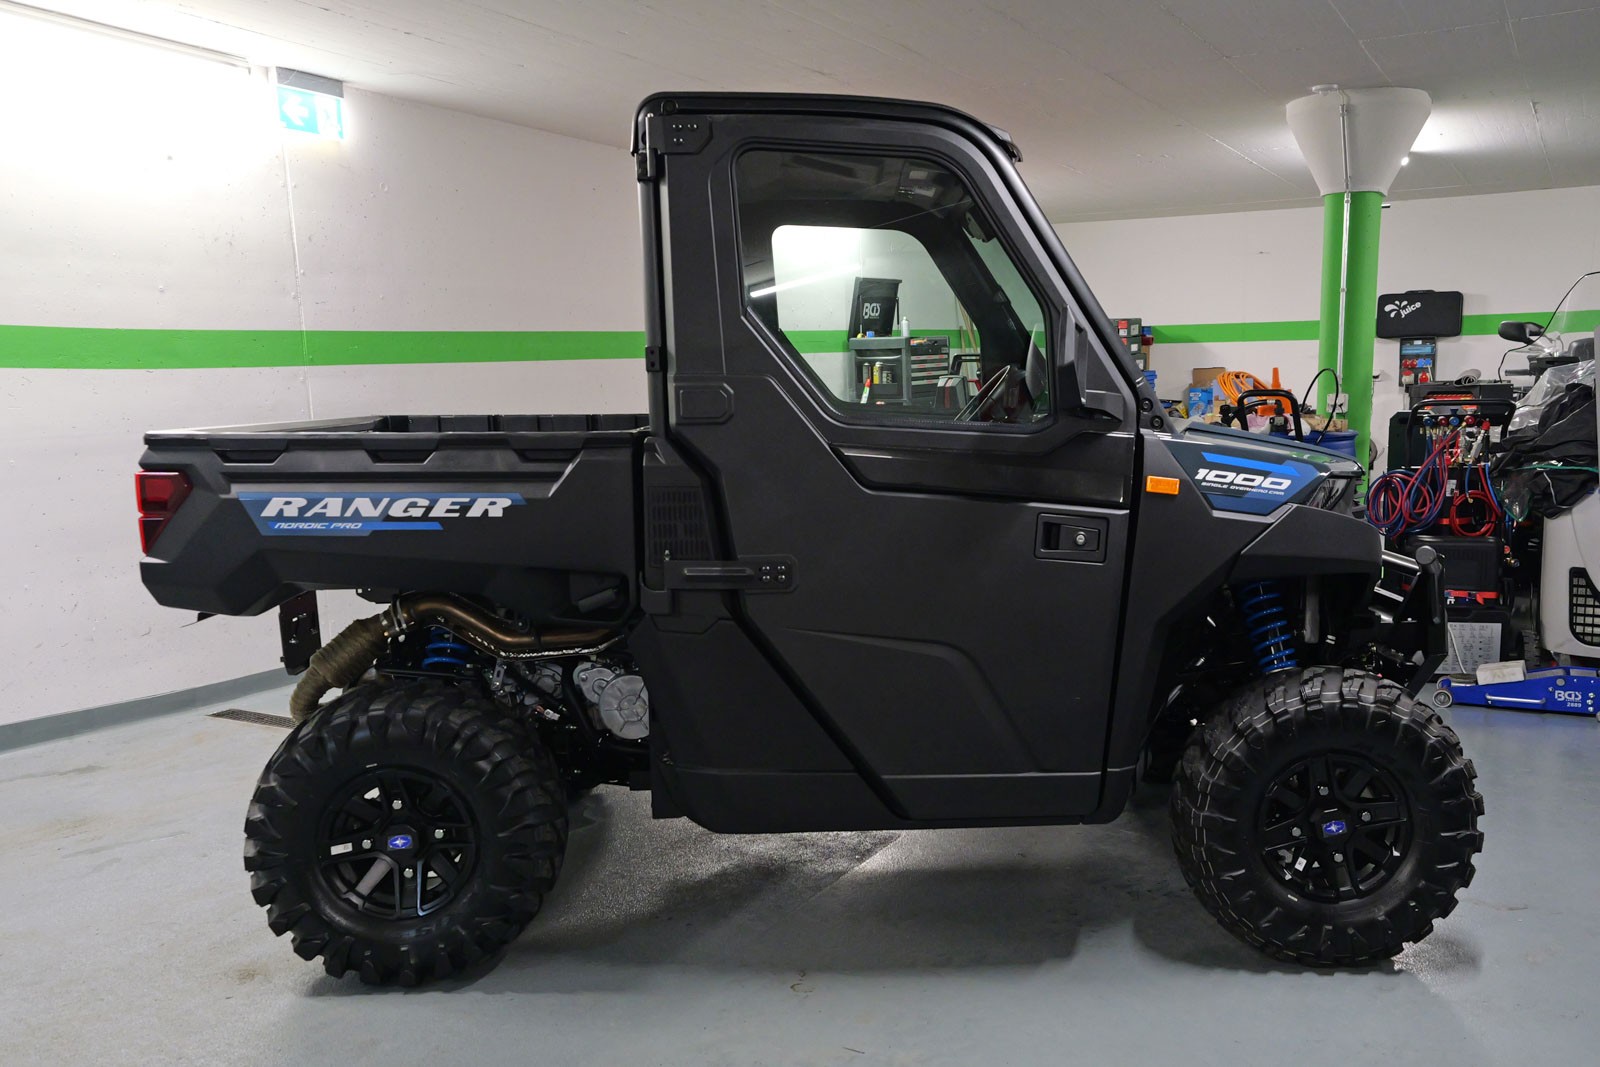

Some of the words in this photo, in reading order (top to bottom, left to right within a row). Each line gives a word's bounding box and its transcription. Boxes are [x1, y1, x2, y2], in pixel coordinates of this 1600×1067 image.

[1399, 301, 1422, 318] juice
[1194, 468, 1292, 490] 1000
[1200, 481, 1229, 489] SINGLE
[1229, 485, 1268, 494] OVERHEAD
[260, 497, 513, 518] RANGER
[1554, 690, 1582, 702] BGS
